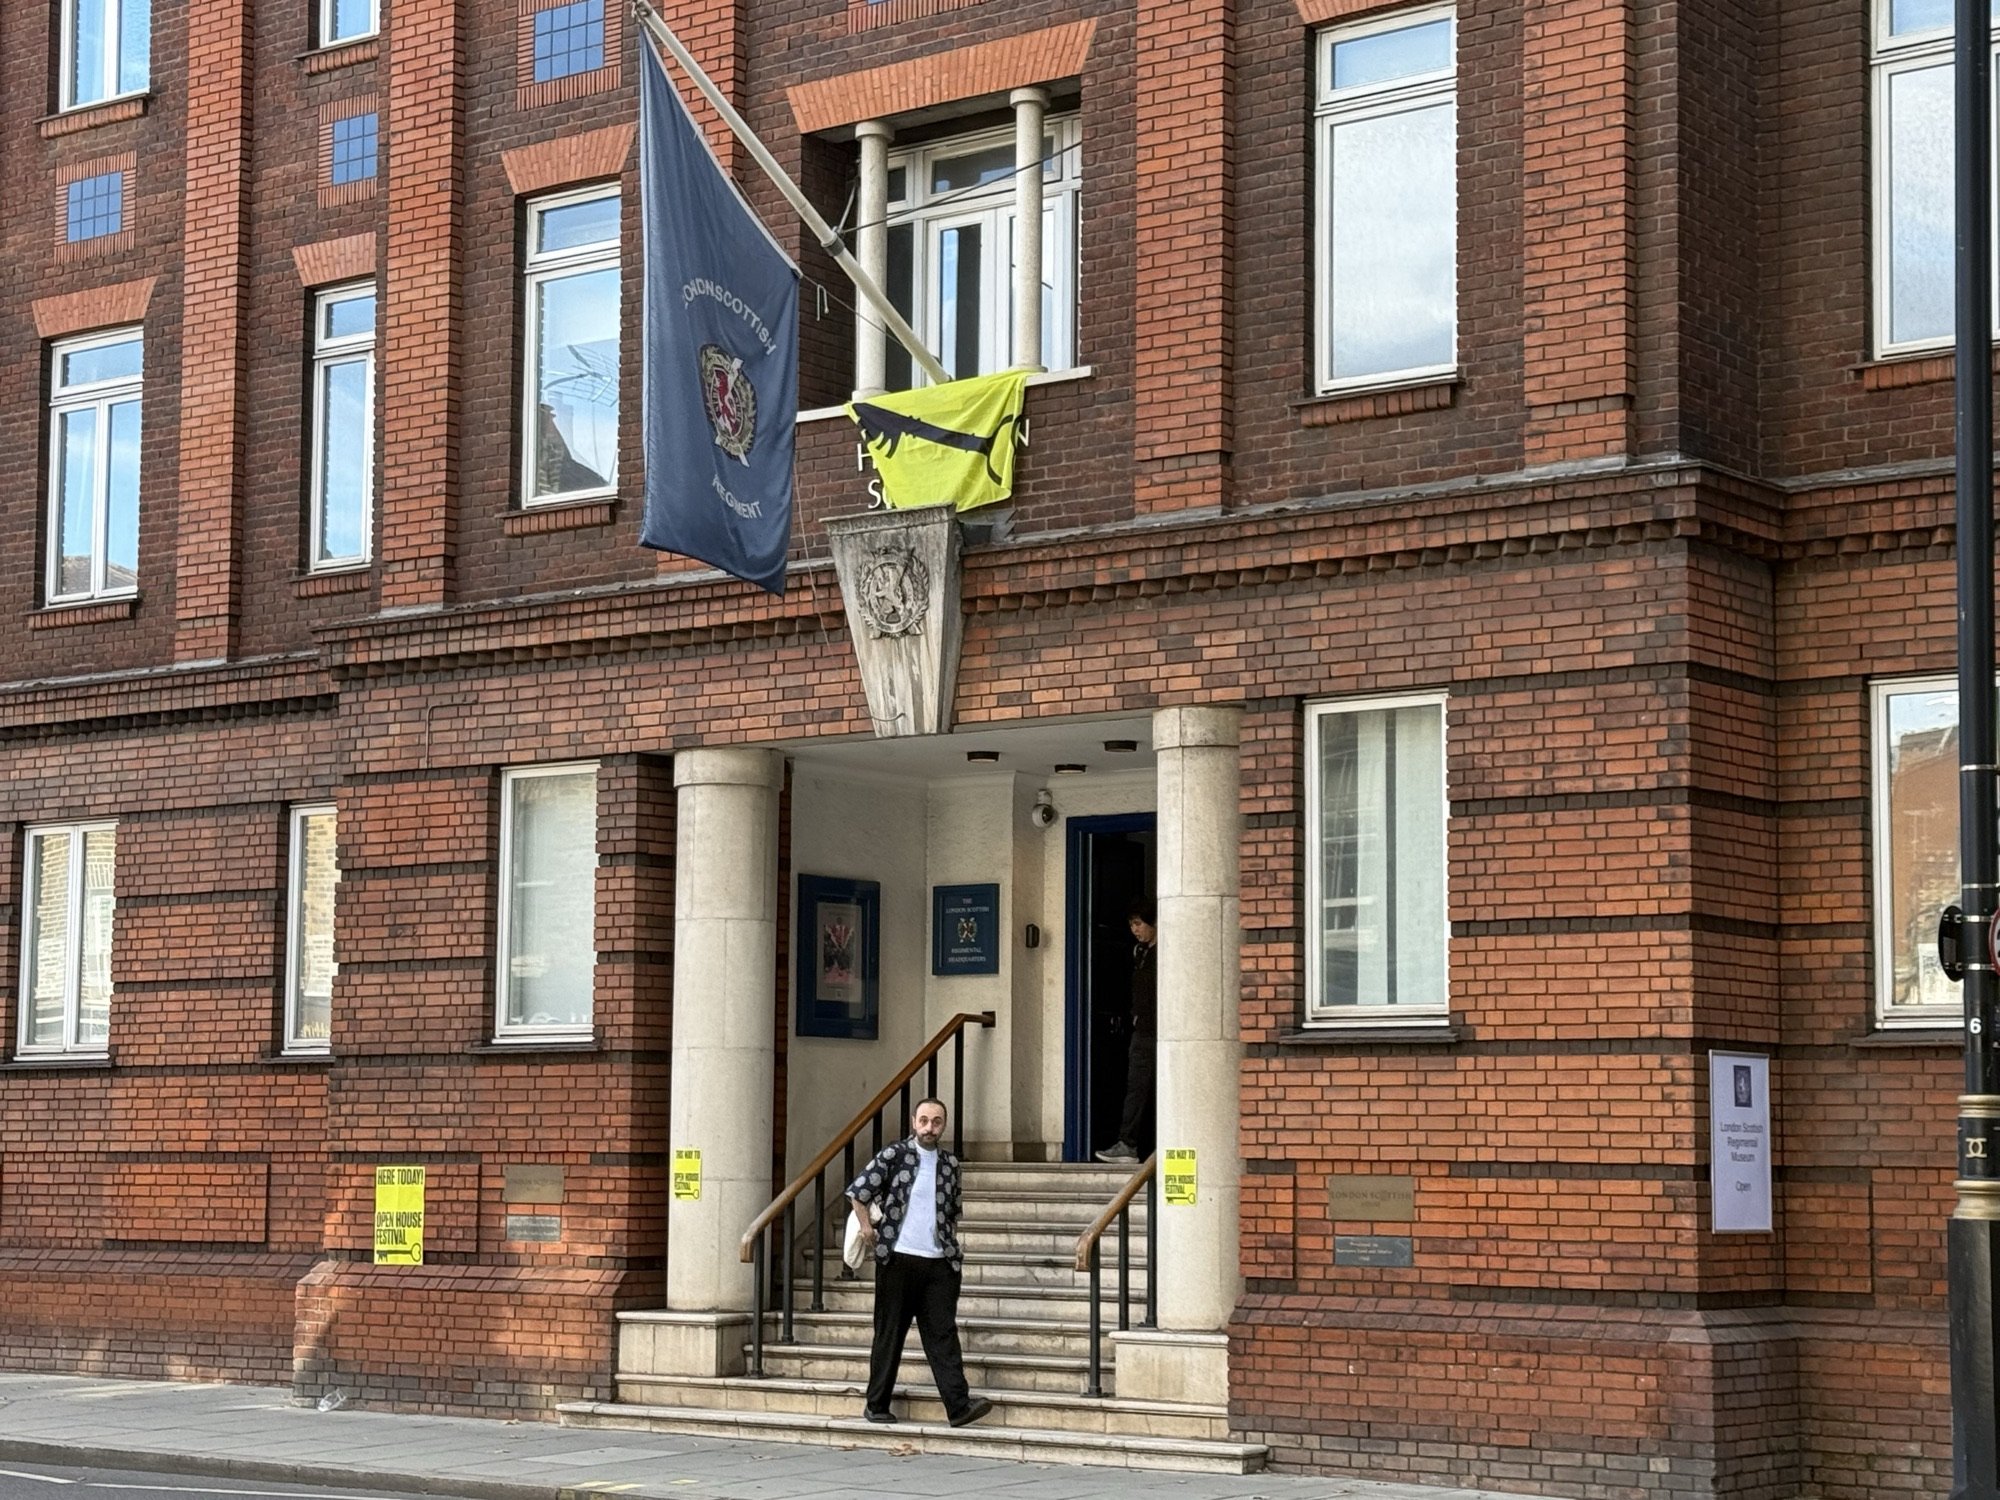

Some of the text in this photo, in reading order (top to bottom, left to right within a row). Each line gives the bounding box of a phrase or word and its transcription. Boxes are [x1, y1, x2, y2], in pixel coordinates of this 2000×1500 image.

[714, 285, 777, 356] SCOTTISH
[1970, 1017, 1982, 1034] 6
[1720, 1121, 1763, 1133] London Scottish
[1727, 1136, 1758, 1150] Regimental
[1731, 1151, 1755, 1162] Museum
[377, 1168, 424, 1185] HERE TODAY!
[1735, 1181, 1752, 1192] Open
[376, 1211, 422, 1228] OPEN HOUSE
[376, 1229, 407, 1245] FESTIVAL
